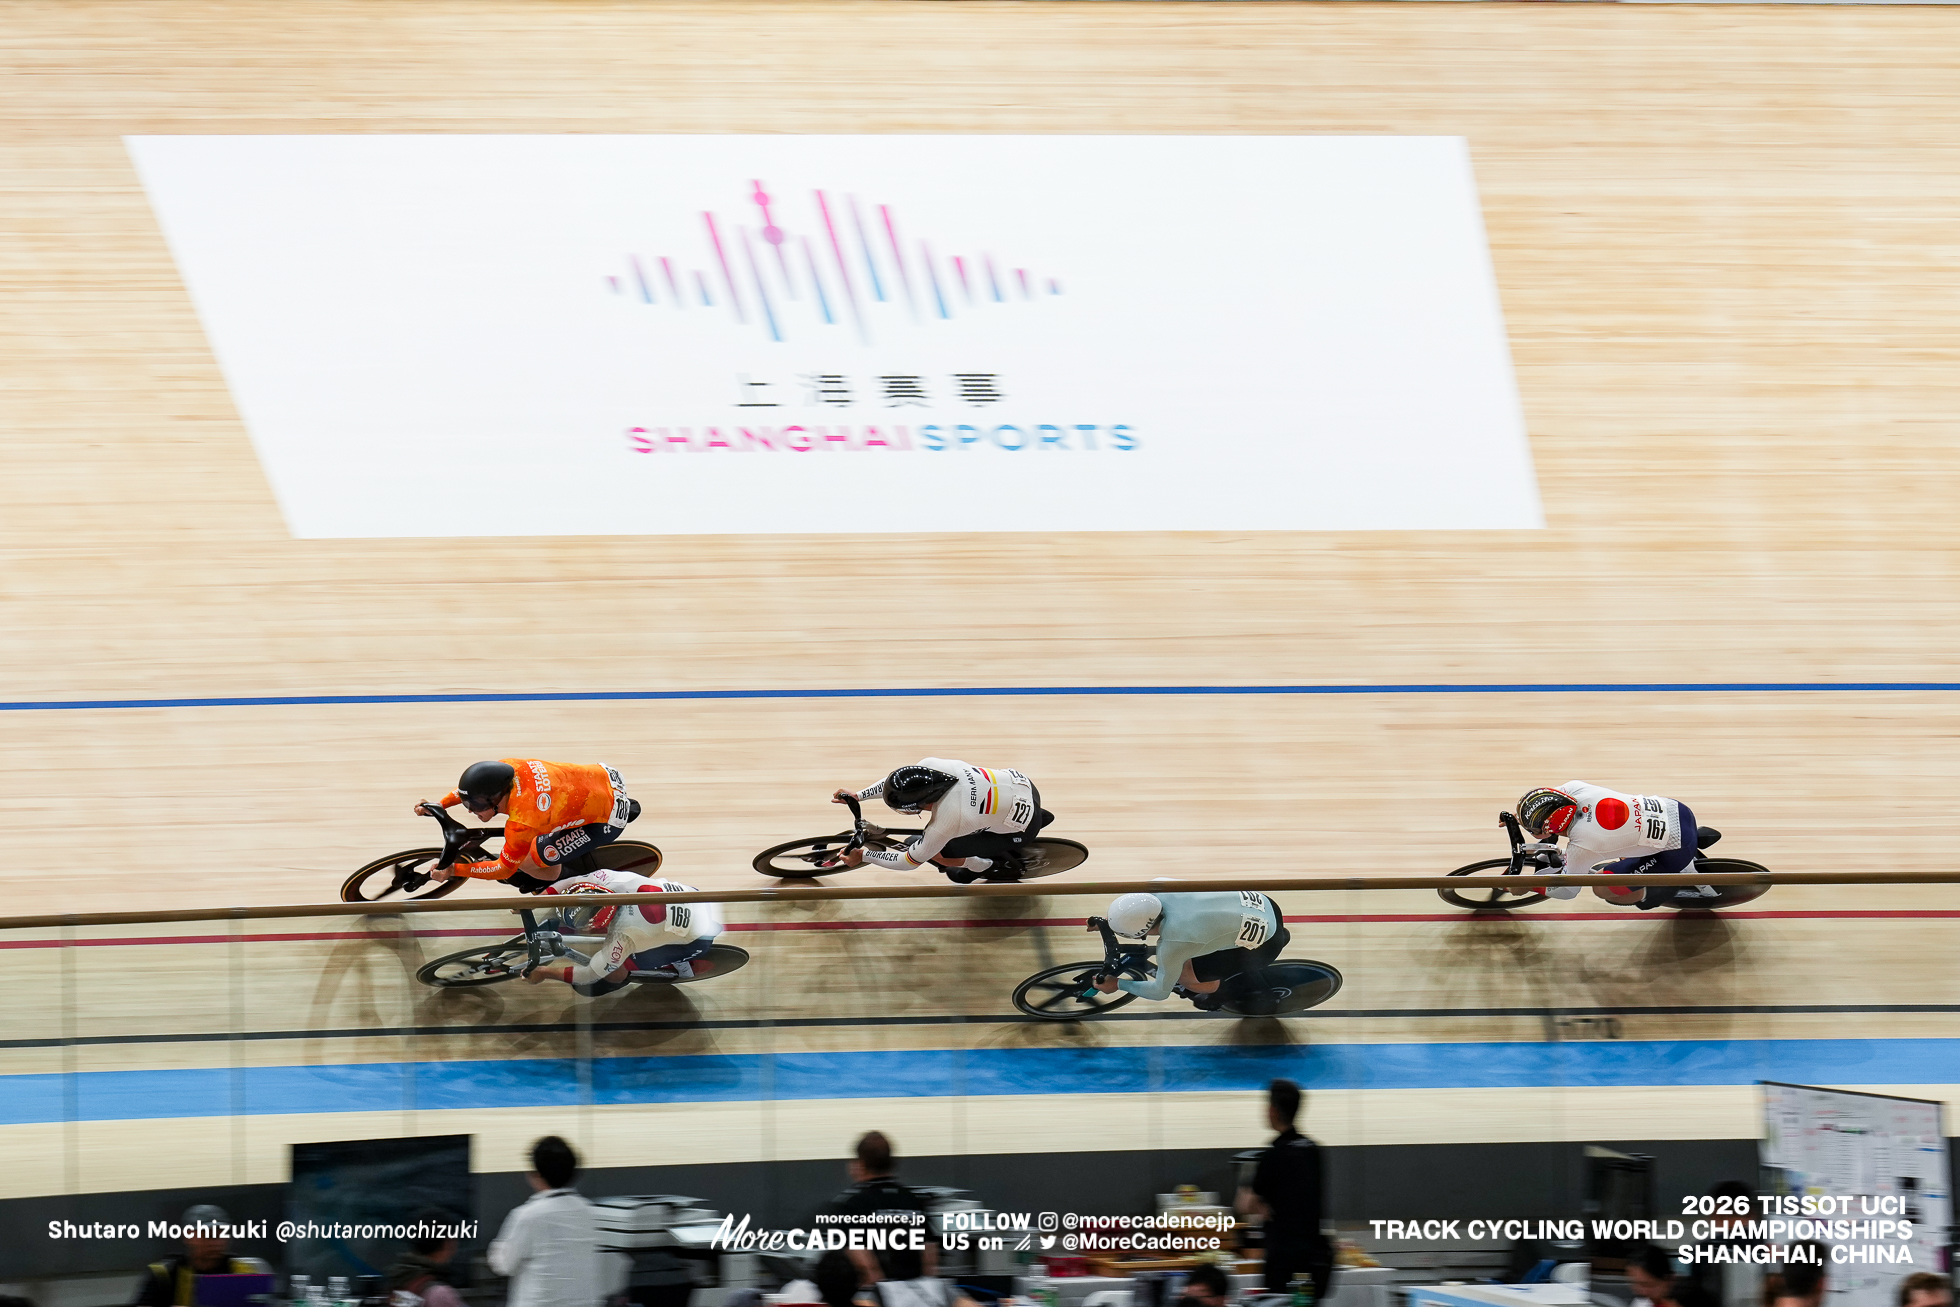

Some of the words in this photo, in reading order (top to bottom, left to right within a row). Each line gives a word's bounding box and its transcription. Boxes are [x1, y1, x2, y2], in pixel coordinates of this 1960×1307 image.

[527, 761, 544, 792] STAATS
[963, 768, 977, 807] GERMANY
[1012, 802, 1031, 825] 127
[1558, 807, 1574, 830] JAPAN
[1631, 798, 1642, 832] JAPAN
[555, 827, 585, 849] STAATS
[1646, 818, 1666, 841] 167
[470, 864, 502, 873] Rabobank
[1633, 858, 1657, 874] APAN
[670, 906, 691, 929] 168
[1240, 921, 1265, 945] 201
